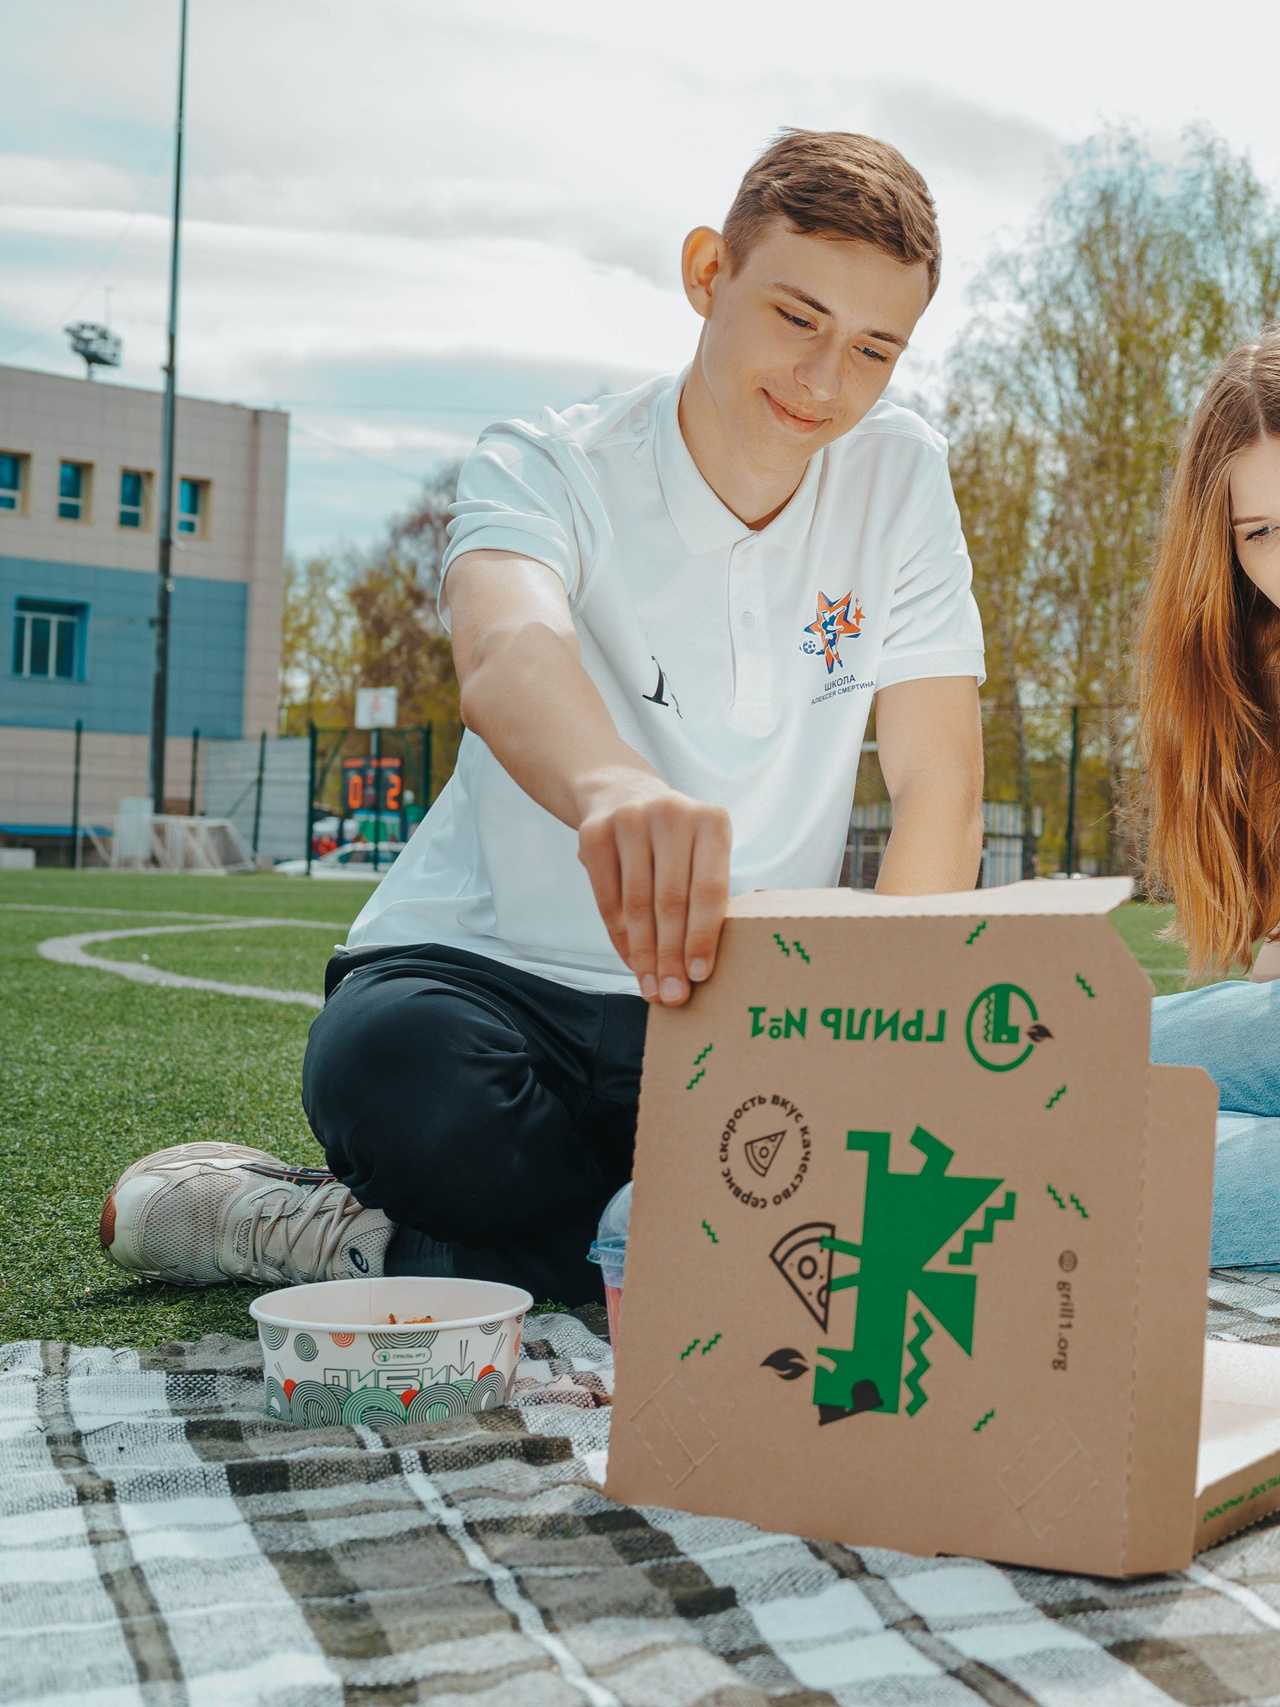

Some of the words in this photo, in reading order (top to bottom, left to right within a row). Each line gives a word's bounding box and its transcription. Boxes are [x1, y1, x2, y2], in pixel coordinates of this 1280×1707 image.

[811, 690, 837, 705] АЛЕКСЕЯ
[837, 680, 875, 695] СМЕРТИНА
[824, 674, 856, 691] ШКОЛА
[748, 1006, 808, 1040] №1
[820, 1007, 947, 1042] ГРИЛЬ
[771, 1094, 804, 1123] вкус
[719, 1095, 767, 1163] скорость
[773, 1125, 811, 1206] качество
[722, 1167, 767, 1209] сервис
[1052, 1280, 1074, 1371] grill1.org
